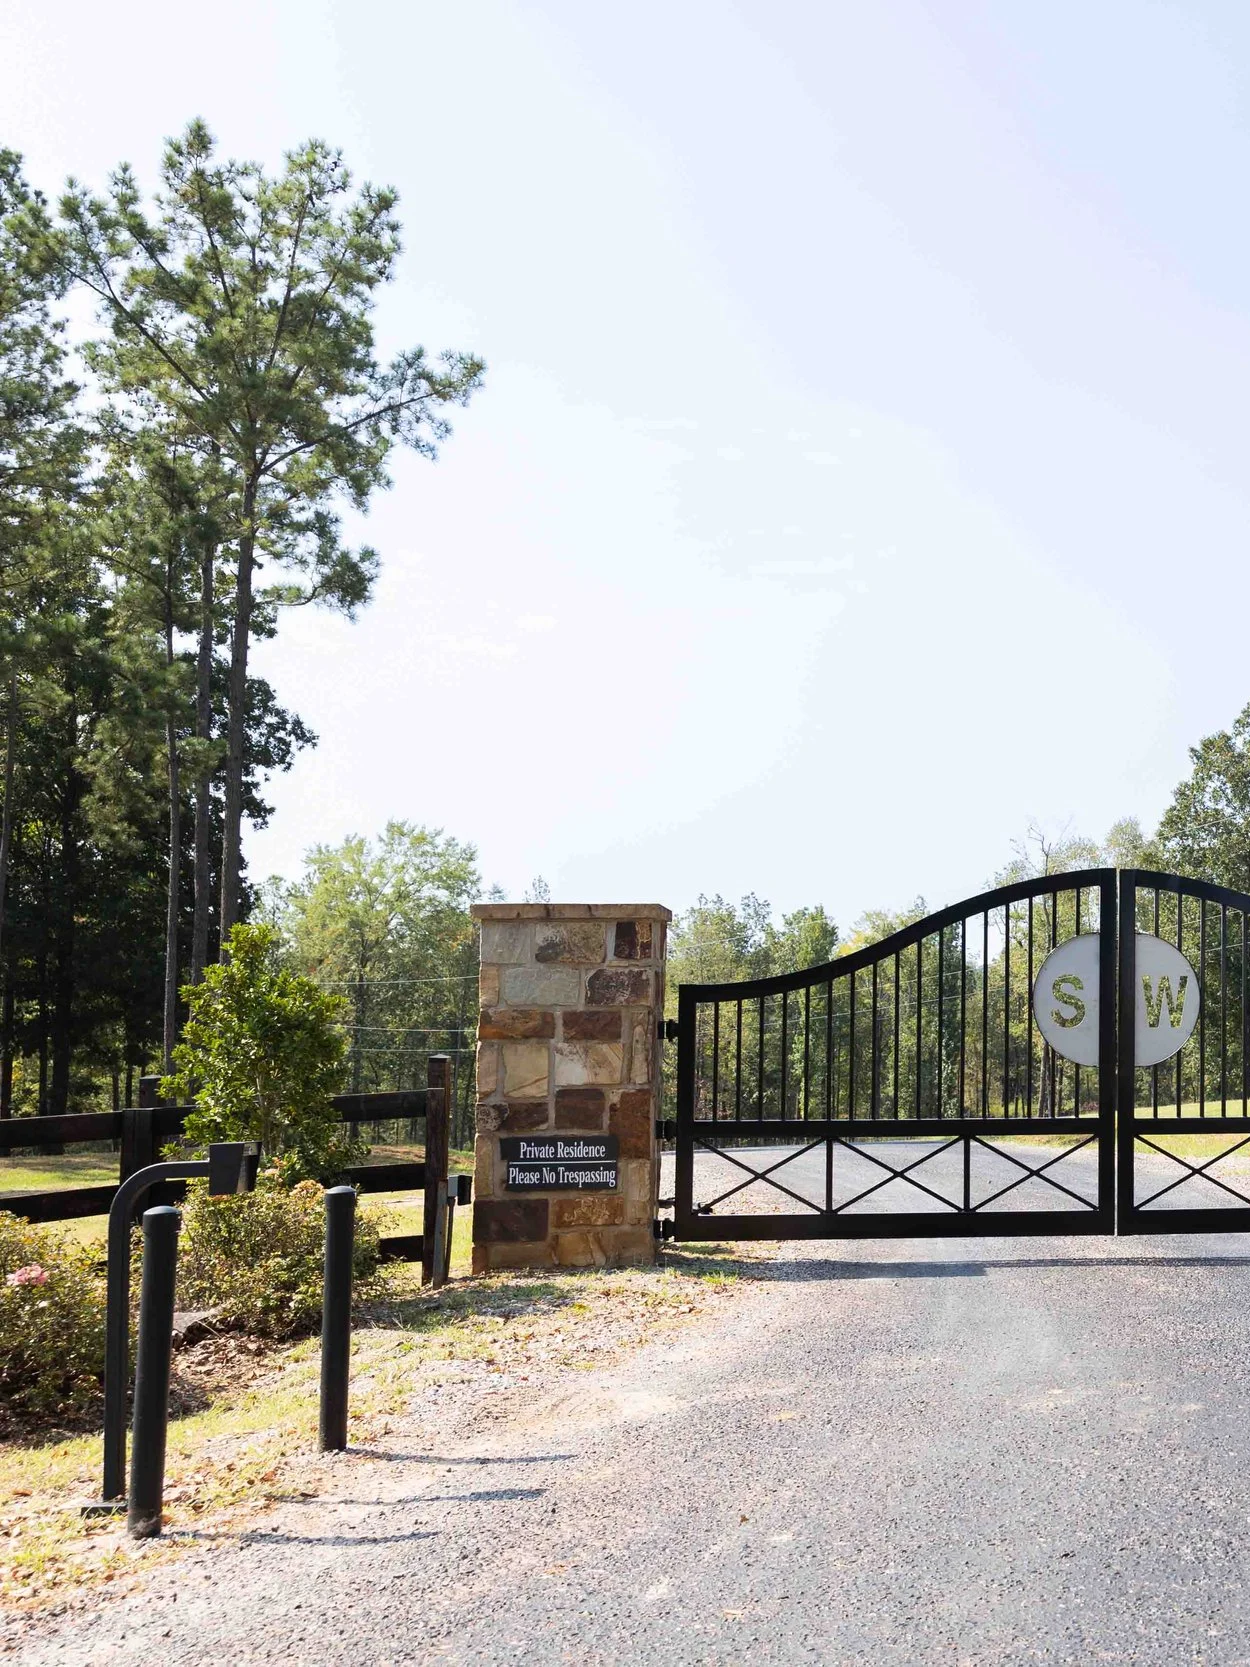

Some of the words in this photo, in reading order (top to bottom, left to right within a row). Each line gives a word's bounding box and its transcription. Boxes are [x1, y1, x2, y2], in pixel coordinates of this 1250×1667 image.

[1051, 974, 1086, 1028] S
[1142, 975, 1188, 1028] W
[520, 1142, 555, 1159] Private
[557, 1141, 606, 1158] Residence
[509, 1167, 540, 1184] Please
[542, 1167, 556, 1184] No
[557, 1167, 616, 1188] Trespassing
